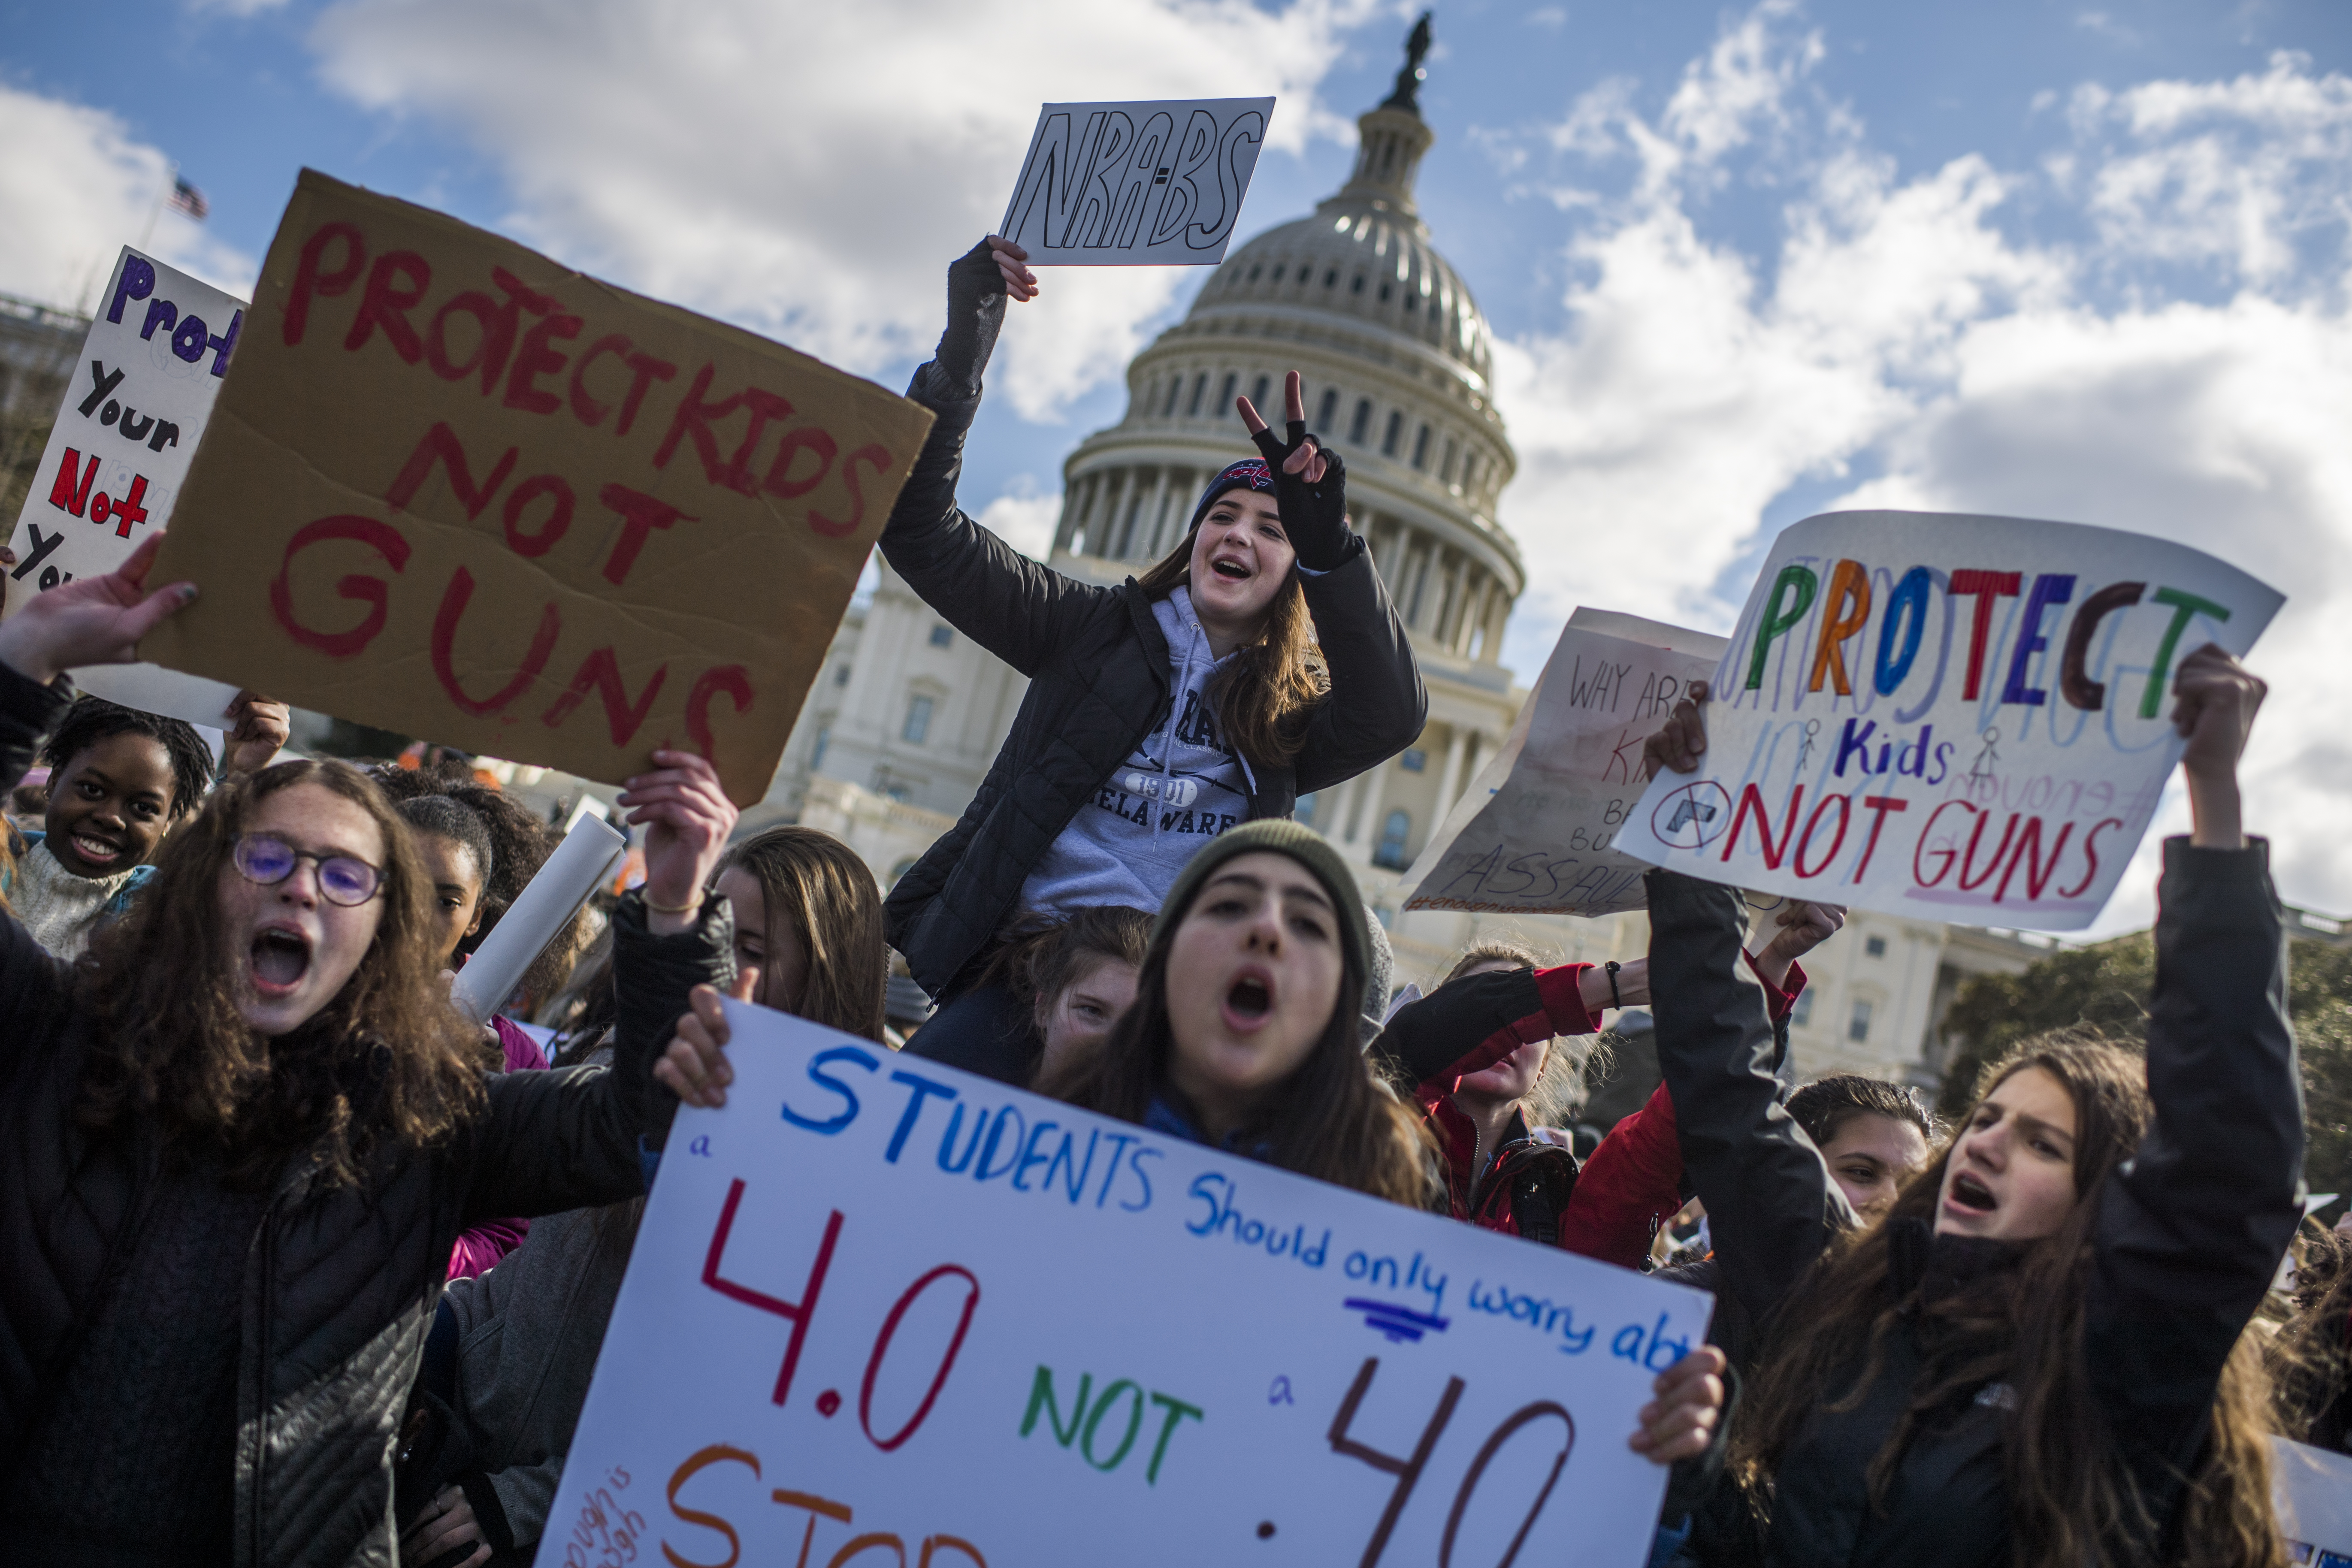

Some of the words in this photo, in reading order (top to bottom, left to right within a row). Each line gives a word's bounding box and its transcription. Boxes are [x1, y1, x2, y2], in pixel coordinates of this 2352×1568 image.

[1003, 109, 1264, 250] NRA=BS
[78, 360, 179, 453] Your
[281, 221, 678, 438] PROTECT
[653, 362, 894, 538] KIDS
[48, 447, 149, 539] Not
[384, 420, 701, 586] NOT
[269, 514, 755, 769] GUNS
[1570, 655, 1632, 713] WHY
[1744, 559, 2232, 720] PROTECT
[1149, 731, 1182, 748] ORIGAL
[1183, 744, 1221, 758] CLASSIC
[1833, 717, 1955, 786] Kids
[1087, 788, 1236, 837] ELAWARE
[1439, 843, 1648, 904] ASSAUL
[1720, 782, 1909, 886] NOT
[1912, 798, 2125, 904] GUNS
[688, 1134, 713, 1158] a
[781, 1045, 1165, 1212] STUDENTS
[1183, 1171, 1332, 1268] Should
[1344, 1251, 1448, 1319] only
[1467, 1279, 1595, 1355] worry
[701, 1177, 981, 1453] 4.0
[1019, 1363, 1205, 1489] NOT
[1267, 1374, 1295, 1405] a
[605, 1464, 632, 1491] is
[661, 1441, 988, 1568] ST
[1255, 1356, 1576, 1568] .40
